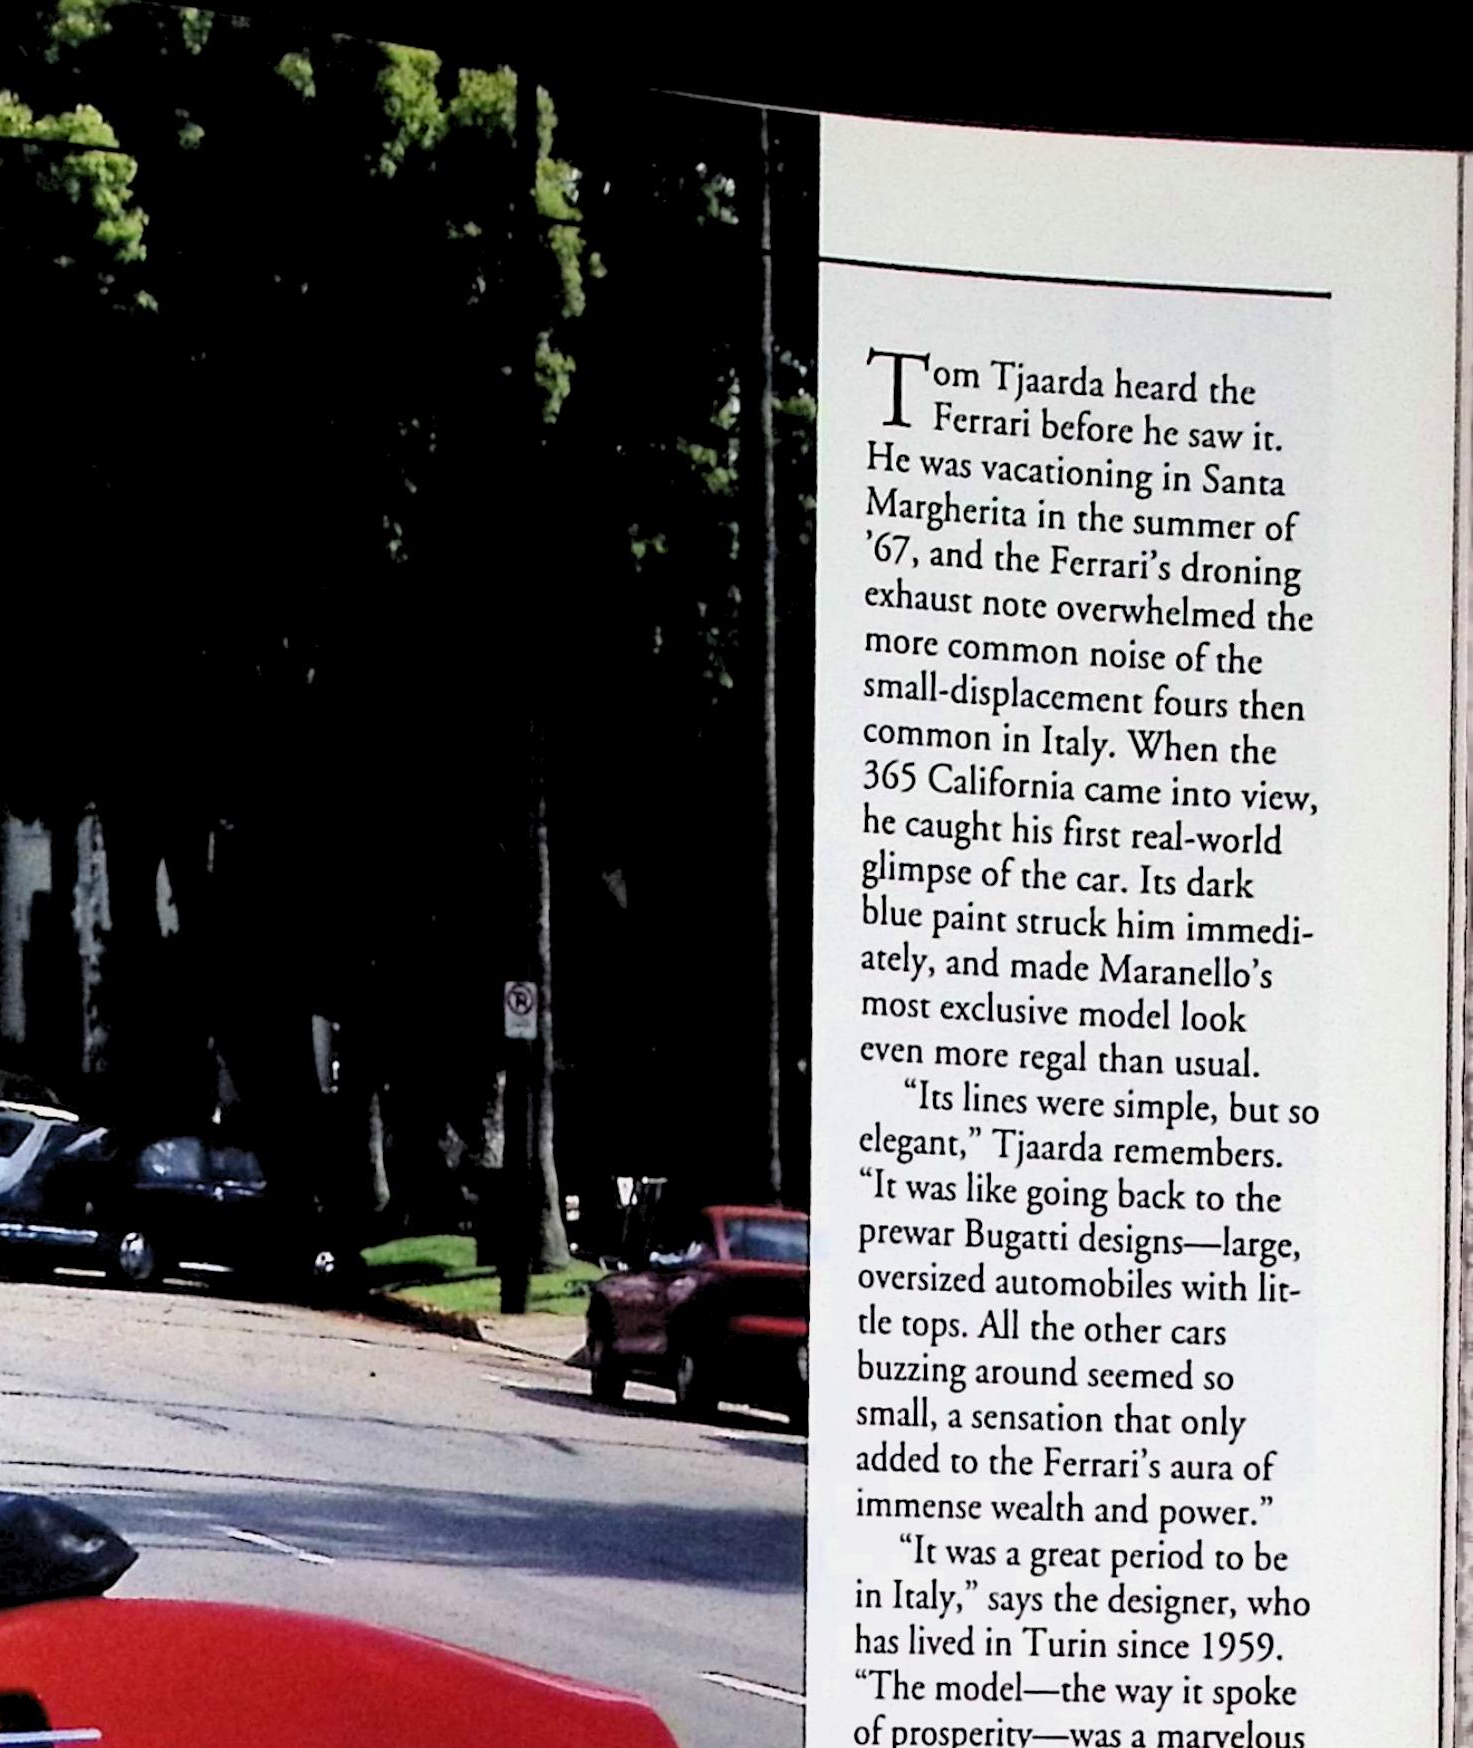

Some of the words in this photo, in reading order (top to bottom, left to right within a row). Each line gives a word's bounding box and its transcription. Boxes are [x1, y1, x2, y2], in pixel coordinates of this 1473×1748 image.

[990, 360, 1104, 402] Tjaarda
[1115, 367, 1197, 402] heard
[1210, 373, 1255, 405] the
[868, 440, 910, 473] He
[920, 456, 971, 478] was
[982, 456, 1153, 500] vacationing
[1163, 462, 1190, 492] in
[1203, 464, 1285, 496] Santa
[865, 577, 972, 614] exhaust
[983, 596, 1047, 619] note
[1058, 594, 1255, 629] overwhelmed
[1268, 600, 1313, 632] the
[864, 670, 1142, 716] small-displacement
[1154, 684, 1227, 718] fours
[1239, 689, 1304, 721] then
[864, 760, 916, 792] 365
[929, 763, 1074, 800] California
[1085, 783, 1161, 804] came
[1172, 776, 1230, 808] into
[1241, 780, 1317, 815] view,
[862, 893, 922, 927] blue
[932, 902, 1006, 938] paint
[1017, 906, 1107, 937] struck
[1118, 907, 1174, 940] him
[1187, 912, 1313, 944] immedi-
[862, 997, 930, 1018] most
[940, 991, 1068, 1025] exclusive
[1079, 998, 1169, 1029] model
[1182, 1000, 1246, 1032] look
[992, 1128, 1102, 1168] Tjaarda
[1114, 1136, 1282, 1168] remembers.
[859, 1224, 954, 1253] prewar
[965, 1218, 1067, 1259] Bugatti
[859, 1303, 891, 1334] tle
[903, 1316, 967, 1347] tops.
[978, 1308, 1018, 1339] All
[1031, 1310, 1074, 1341] the
[1085, 1312, 1161, 1343] other
[1171, 1326, 1226, 1345] cars
[857, 1441, 940, 1473] added
[951, 1454, 978, 1474] to
[990, 1444, 1033, 1475] the
[1171, 1461, 1233, 1480] aura
[1244, 1450, 1277, 1481] of
[857, 1488, 981, 1519] immense
[991, 1491, 1084, 1521] wealth
[1095, 1493, 1148, 1523] and
[855, 1623, 898, 1654] has
[909, 1624, 974, 1655] lived
[986, 1627, 1011, 1656] in
[1022, 1627, 1106, 1657] Turin
[1117, 1630, 1189, 1659] since
[1204, 1632, 1282, 1662] 1959.
